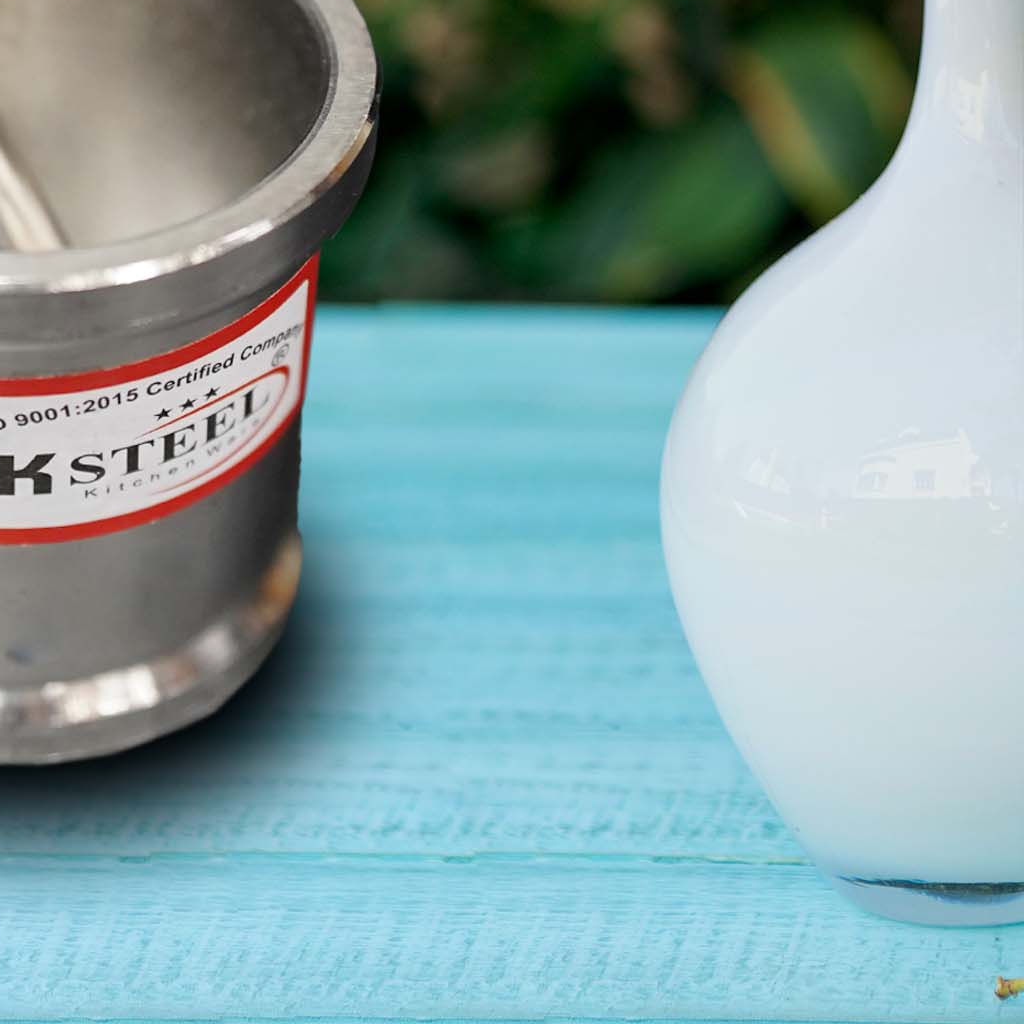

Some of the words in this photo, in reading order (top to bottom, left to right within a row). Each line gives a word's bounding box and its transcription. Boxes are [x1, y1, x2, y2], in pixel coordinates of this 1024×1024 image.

[14, 388, 139, 427] 9001:2015
[146, 352, 235, 396] Certified
[69, 385, 271, 487] STEEL
[84, 460, 196, 499] Kitchen
